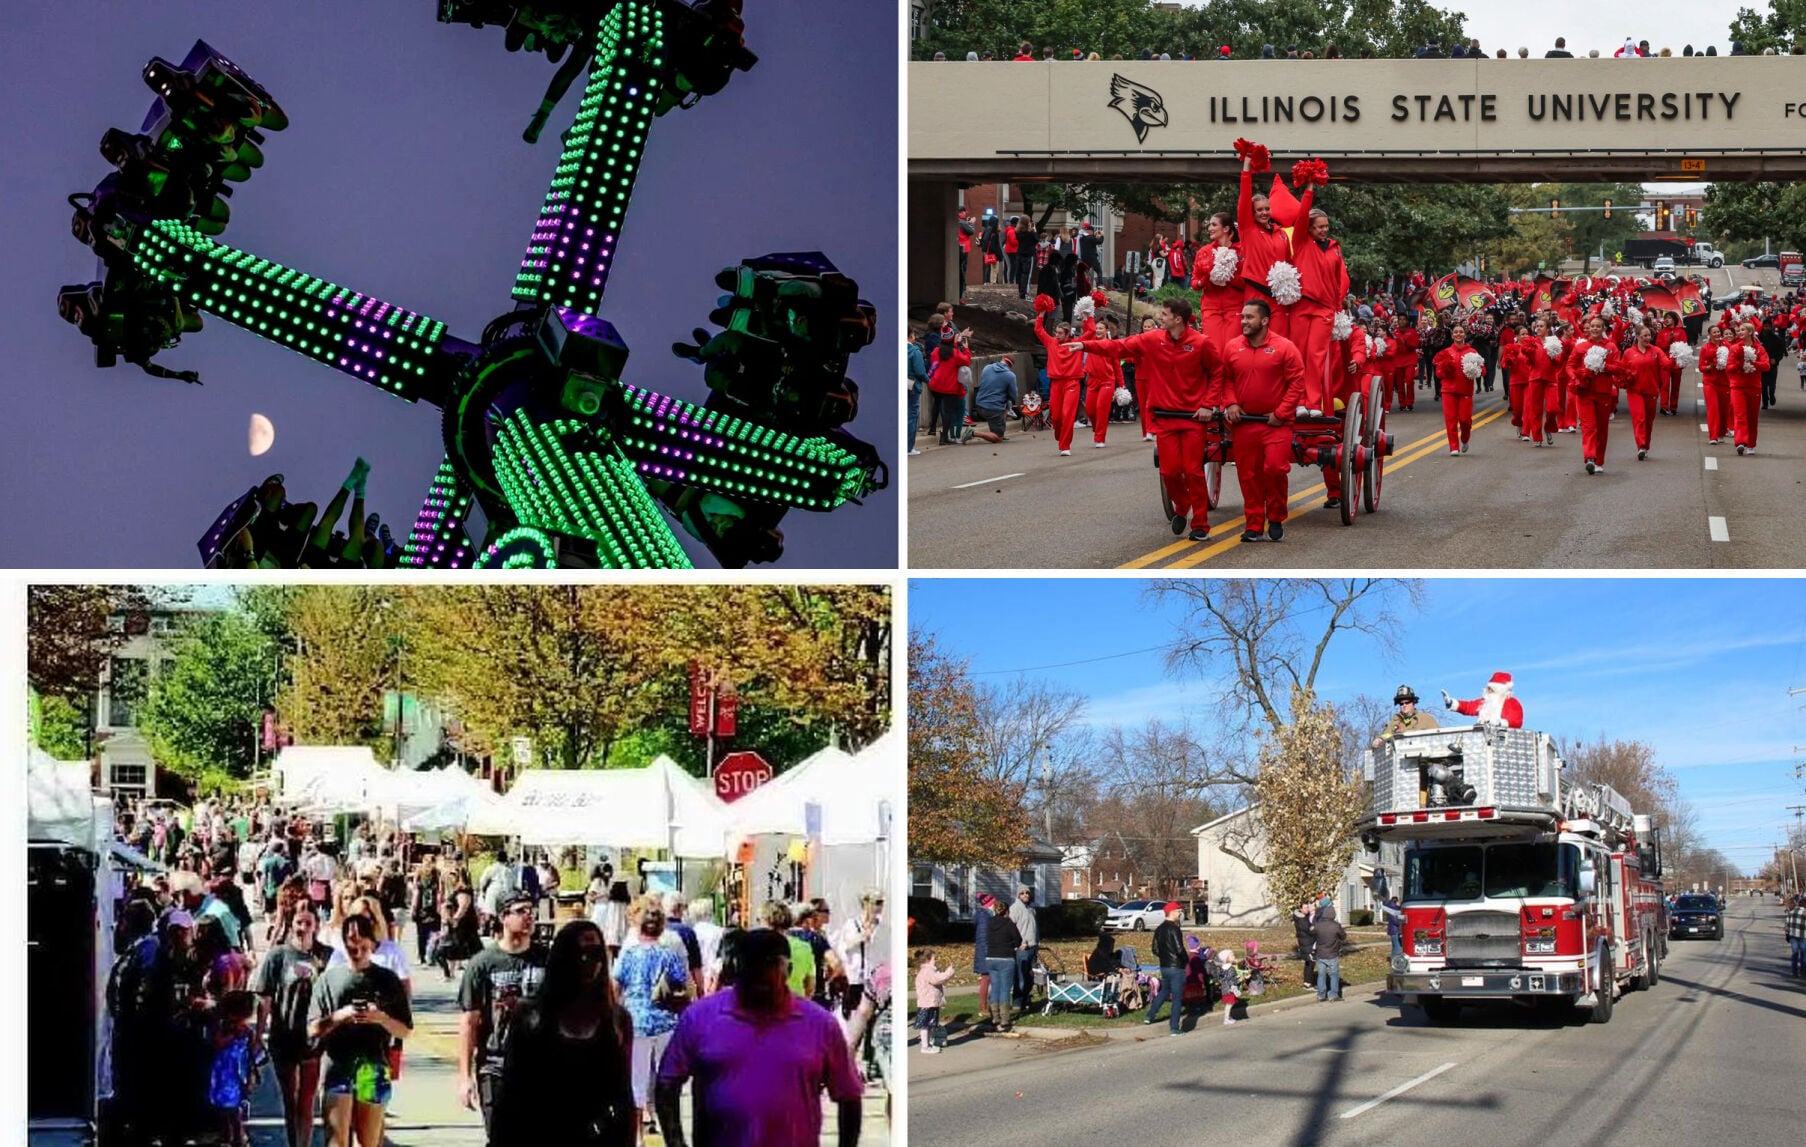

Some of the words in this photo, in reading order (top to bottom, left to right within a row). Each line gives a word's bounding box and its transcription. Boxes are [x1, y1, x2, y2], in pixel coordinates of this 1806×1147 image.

[1210, 95, 1361, 123] ILLINOIS
[1391, 94, 1497, 122] STATE
[1528, 92, 1741, 121] UNIVERSITY
[719, 769, 769, 793] STOP
